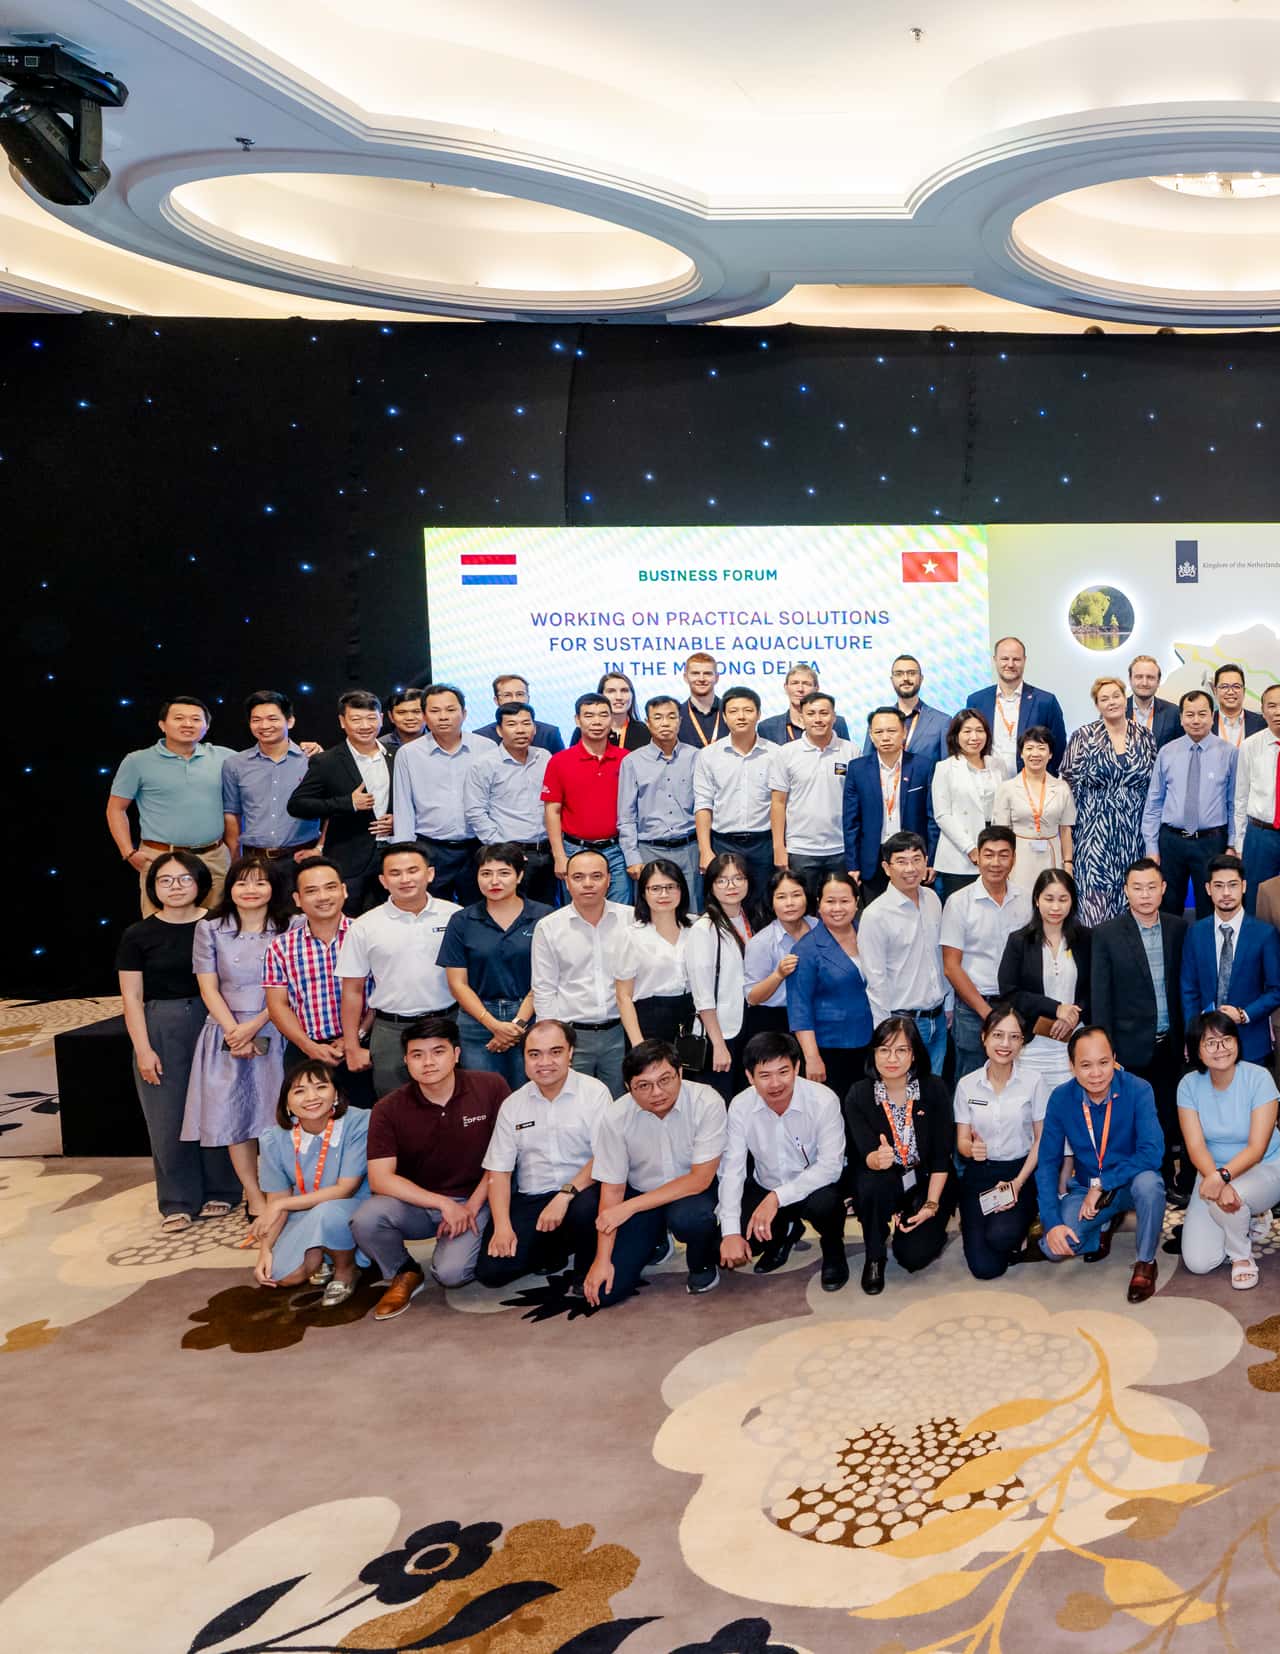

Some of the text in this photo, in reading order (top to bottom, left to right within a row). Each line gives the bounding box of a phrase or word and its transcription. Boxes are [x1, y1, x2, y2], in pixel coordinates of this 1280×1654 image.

[638, 569, 778, 582] BUSINESS FORUM
[530, 610, 890, 627] WORKING ON PRACTICAL SOLUTIONS
[549, 635, 873, 652] FOR SUSTAINABLE AQUACULTURE
[603, 661, 624, 674] IN
[629, 661, 667, 676] THE
[673, 660, 756, 676] MONG
